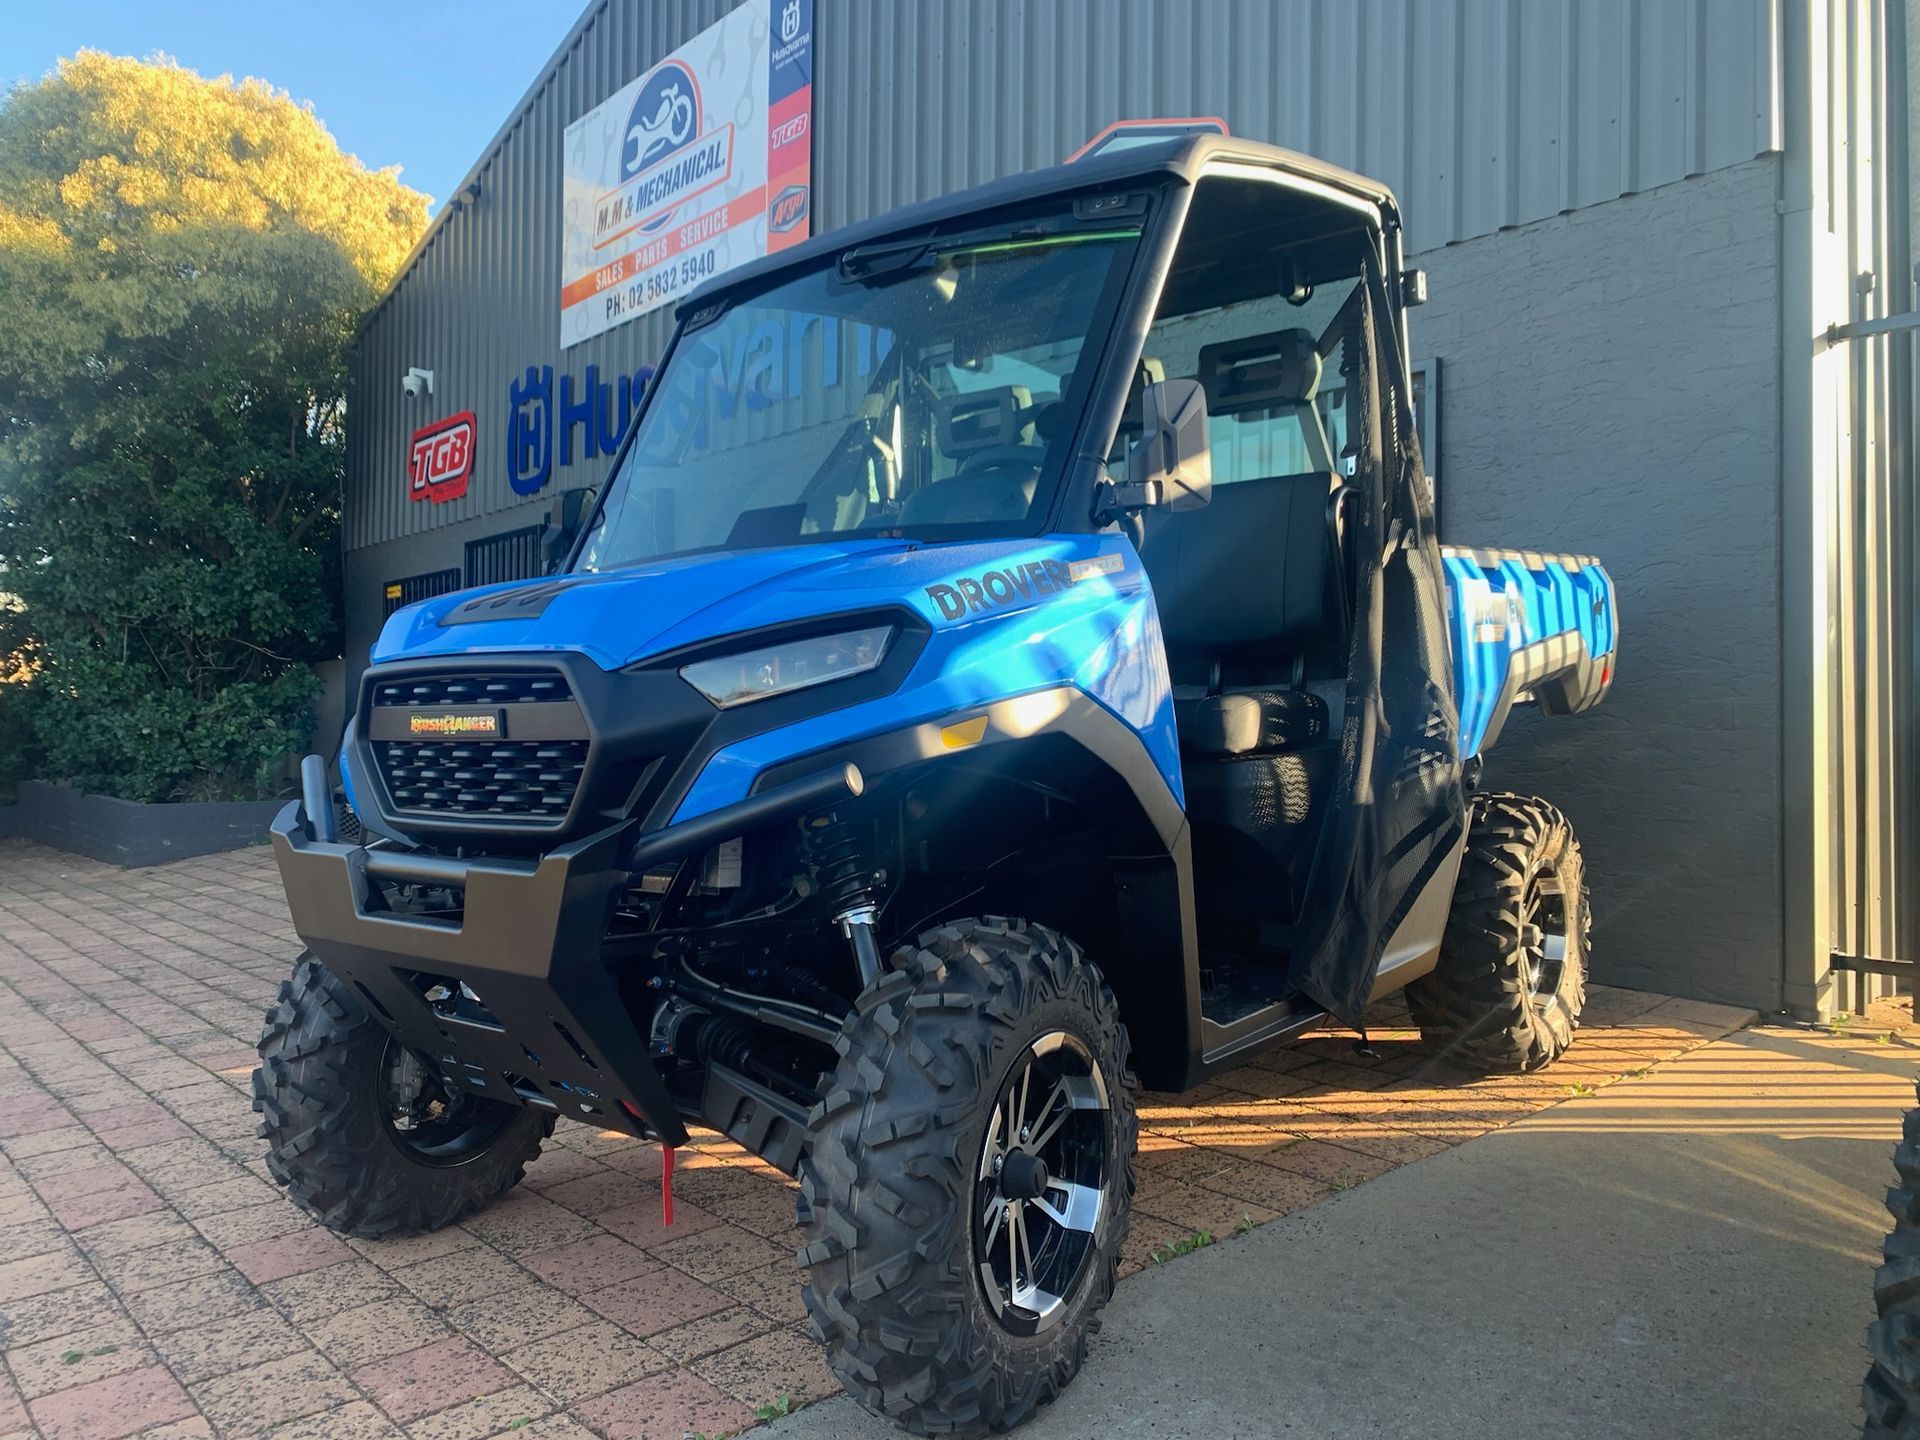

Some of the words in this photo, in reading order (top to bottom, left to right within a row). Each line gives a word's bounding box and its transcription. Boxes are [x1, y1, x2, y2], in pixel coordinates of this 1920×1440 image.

[771, 31, 810, 63] Husqvarna
[772, 112, 808, 149] TGB
[597, 197, 623, 236] M.M
[625, 196, 633, 218] &
[636, 141, 725, 213] MECHANICAL.
[595, 260, 624, 291] SALES
[635, 238, 667, 272] PARTS
[680, 208, 728, 248] SERVICE
[606, 296, 625, 320] PH:
[629, 283, 643, 309] 02
[649, 266, 677, 298] 5832
[681, 249, 715, 284] 5940
[413, 423, 470, 489] TGB
[925, 558, 1078, 621] DROVER
